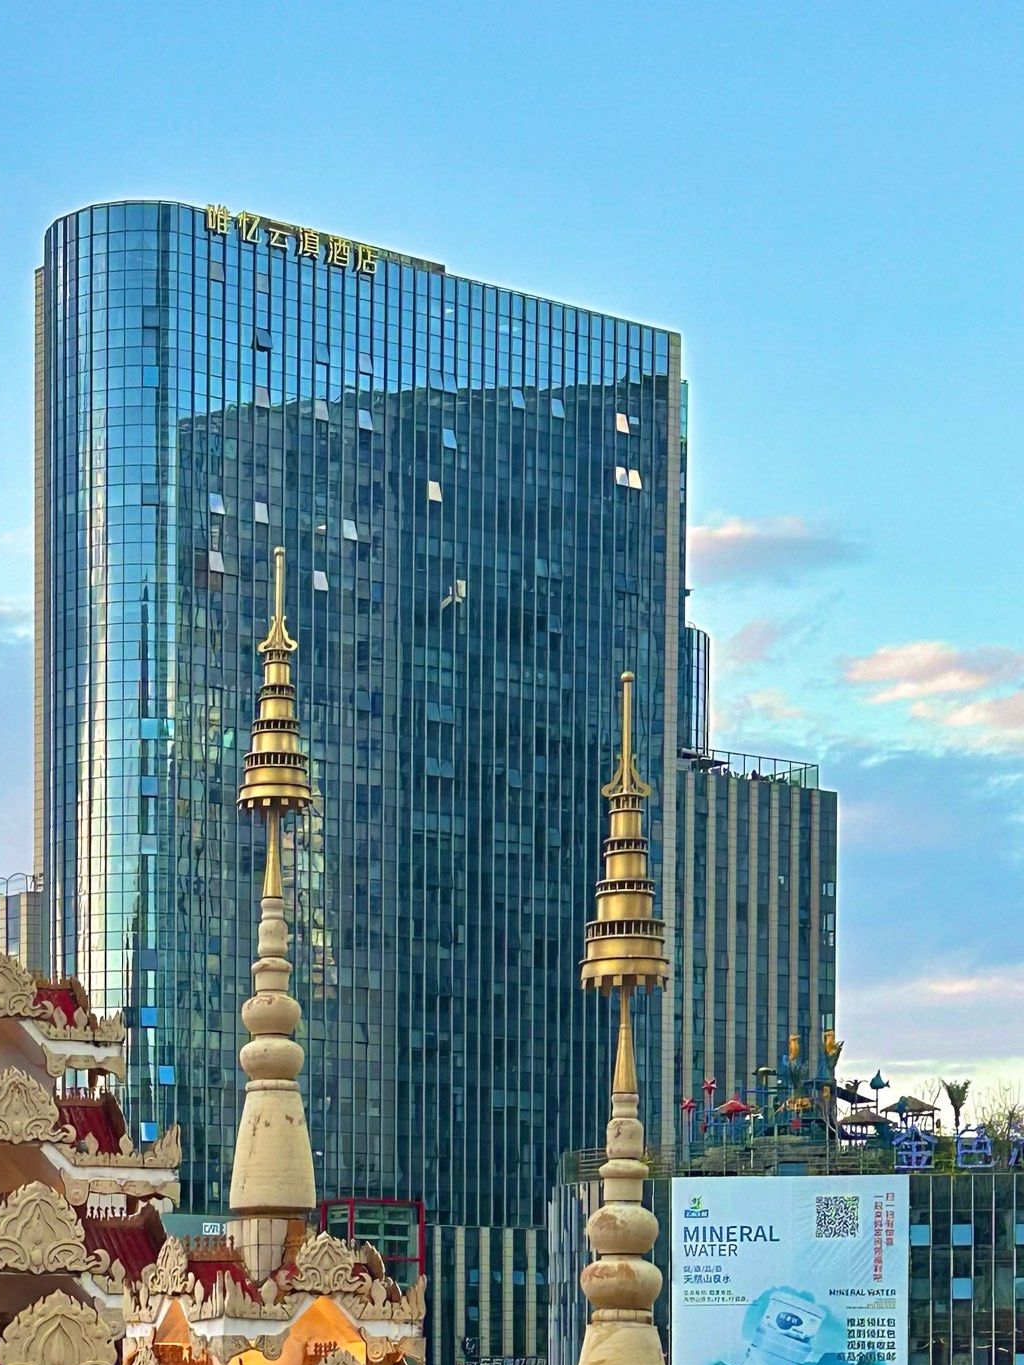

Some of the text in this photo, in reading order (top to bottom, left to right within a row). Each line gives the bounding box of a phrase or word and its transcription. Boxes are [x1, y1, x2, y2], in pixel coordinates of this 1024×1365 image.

[892, 1124, 1024, 1168] 金色
[683, 1225, 780, 1243] MINERAL
[683, 1244, 738, 1257] WATER
[829, 1288, 896, 1297] MINERAL WATER
